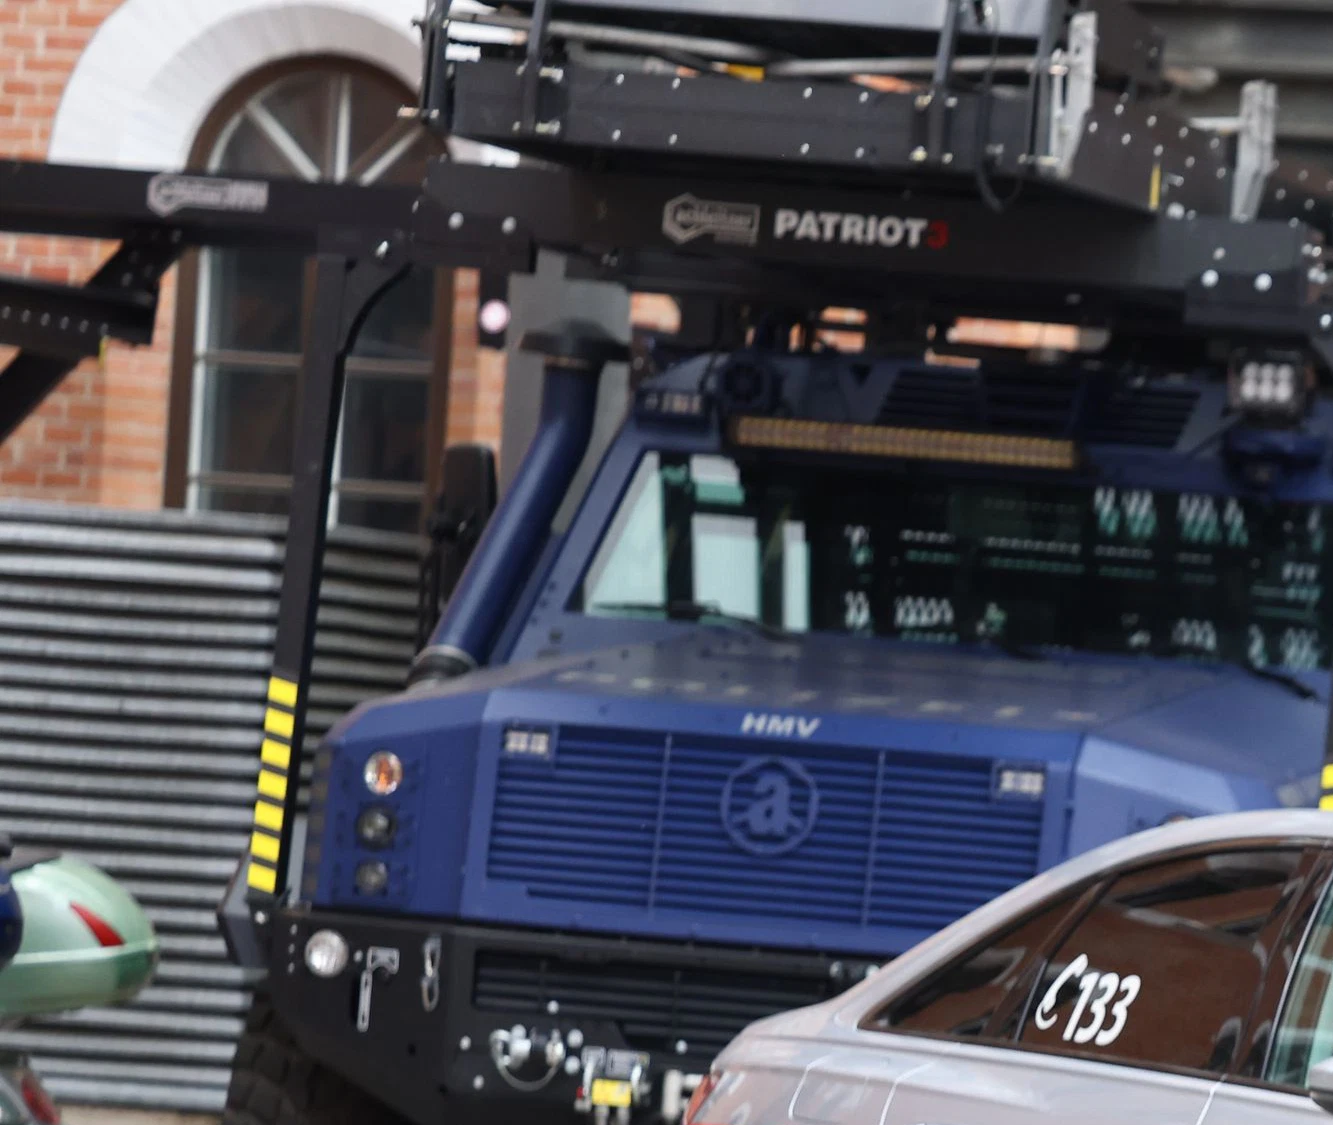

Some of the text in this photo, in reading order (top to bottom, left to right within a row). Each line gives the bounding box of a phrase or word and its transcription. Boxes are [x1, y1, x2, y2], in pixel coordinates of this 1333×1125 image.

[773, 208, 950, 249] PATRIOT3
[740, 711, 822, 738] HMV
[1062, 971, 1142, 1047] 133
